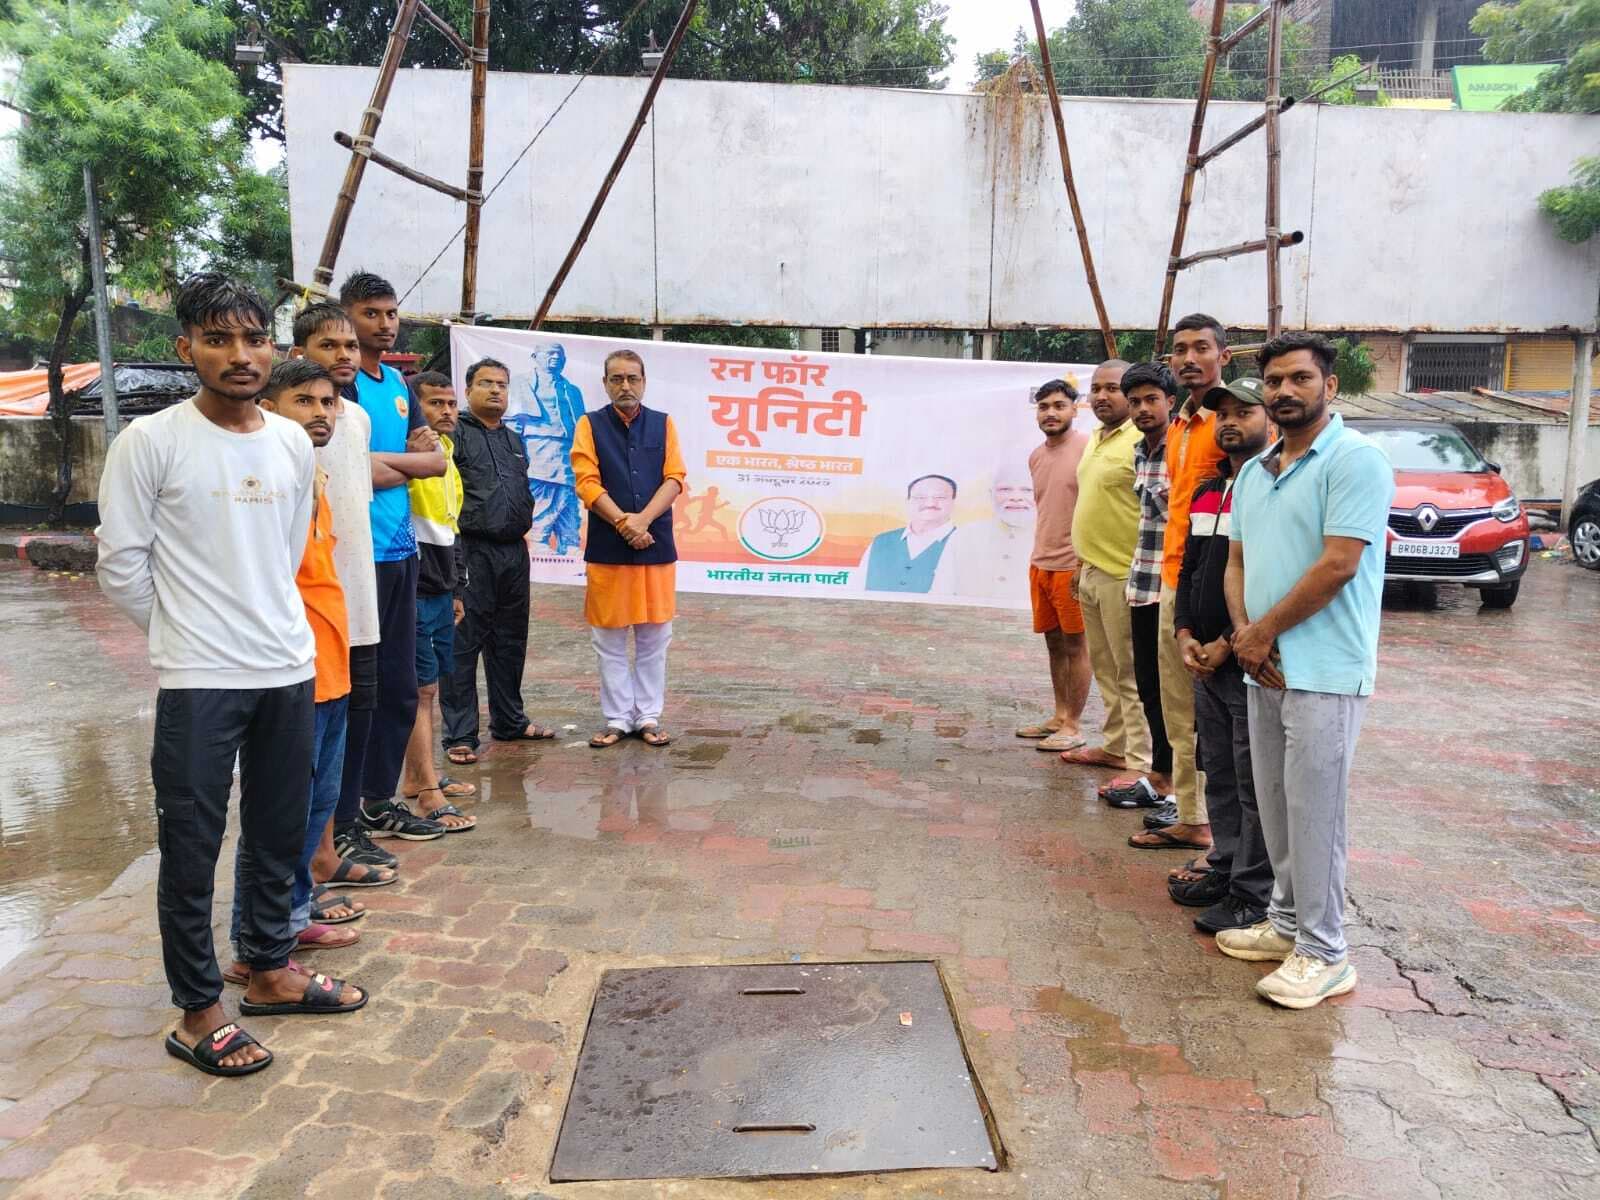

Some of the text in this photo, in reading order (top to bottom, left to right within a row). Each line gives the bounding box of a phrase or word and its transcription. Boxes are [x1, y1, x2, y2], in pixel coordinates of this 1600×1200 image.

[709, 355, 830, 387] रन फॉर
[708, 386, 868, 448] यूनिटी
[716, 455, 741, 467] एक
[744, 457, 783, 469] भारत,
[820, 460, 854, 472] भारत
[737, 473, 750, 482] 31
[1398, 544, 1458, 556] BR06BJ3276
[707, 567, 850, 585] भारतीय जनता पार्टी
